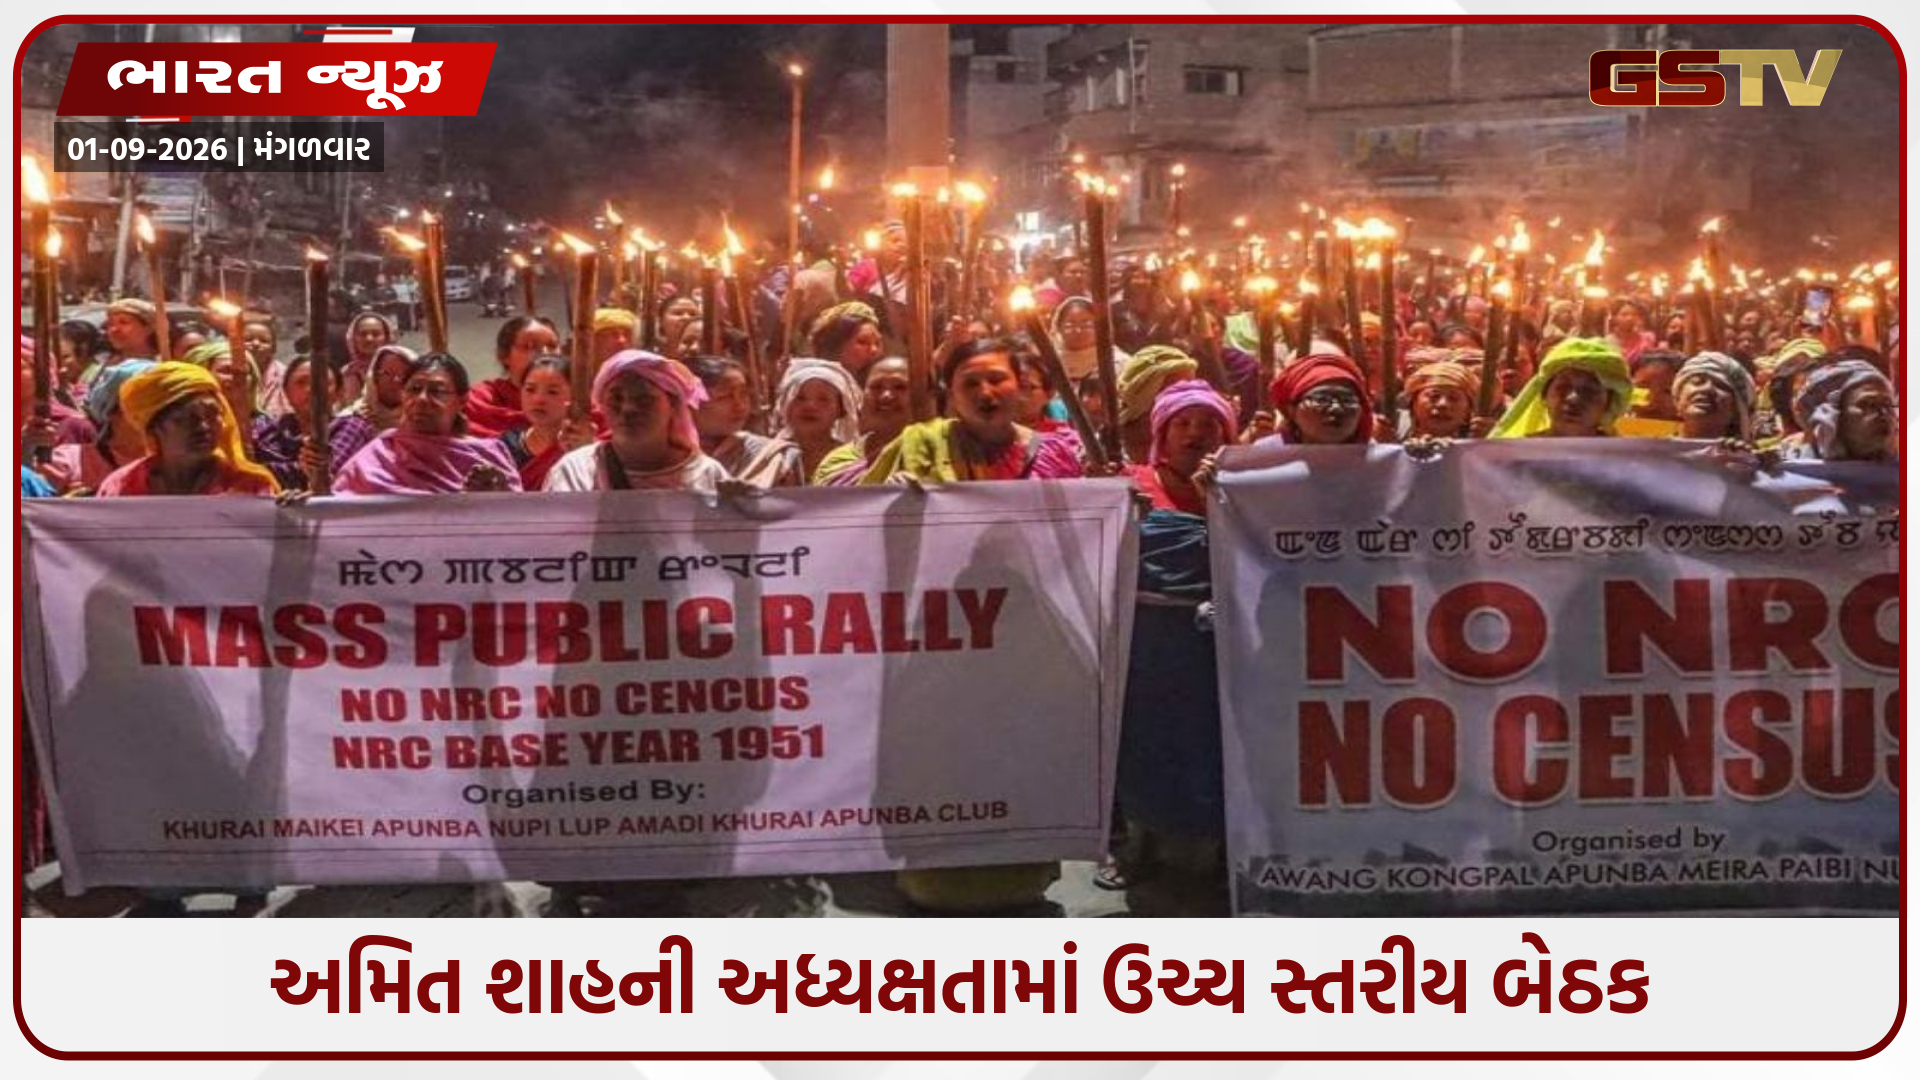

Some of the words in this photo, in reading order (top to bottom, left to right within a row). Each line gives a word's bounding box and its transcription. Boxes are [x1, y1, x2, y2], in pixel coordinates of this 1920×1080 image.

[134, 603, 389, 670] MASS
[414, 594, 735, 668] PUBLIC
[760, 586, 1009, 657] RALLY
[1305, 580, 1548, 682] NO
[340, 687, 408, 723] NO
[420, 685, 521, 722] NRC
[534, 682, 603, 719] NO
[614, 675, 812, 716] CENCUS
[333, 734, 432, 770] NRC
[444, 732, 569, 769] BASE
[579, 729, 703, 764] YEAR
[711, 723, 825, 761] 1951
[1298, 698, 1457, 805] NO
[1493, 688, 1899, 803] CENSU
[461, 780, 641, 809] Organised
[650, 780, 707, 804] By:
[163, 818, 266, 841] KHURAI
[272, 818, 364, 839] MAIKEI
[371, 817, 482, 840] APUNBA
[489, 817, 551, 839] NUPI
[559, 815, 611, 838] LUP
[617, 814, 705, 837] AMADI
[711, 811, 814, 834] KHURAI
[819, 805, 931, 829] APUNBA
[937, 800, 1009, 824] CLUB
[1532, 828, 1682, 854] Organised
[1693, 826, 1727, 853] by
[1261, 868, 1376, 890] AWANG
[1388, 865, 1534, 888] KONGPAL
[1544, 863, 1668, 886] APUNBA
[1679, 860, 1767, 882] MEIRA
[1780, 858, 1850, 879] PAIBI
